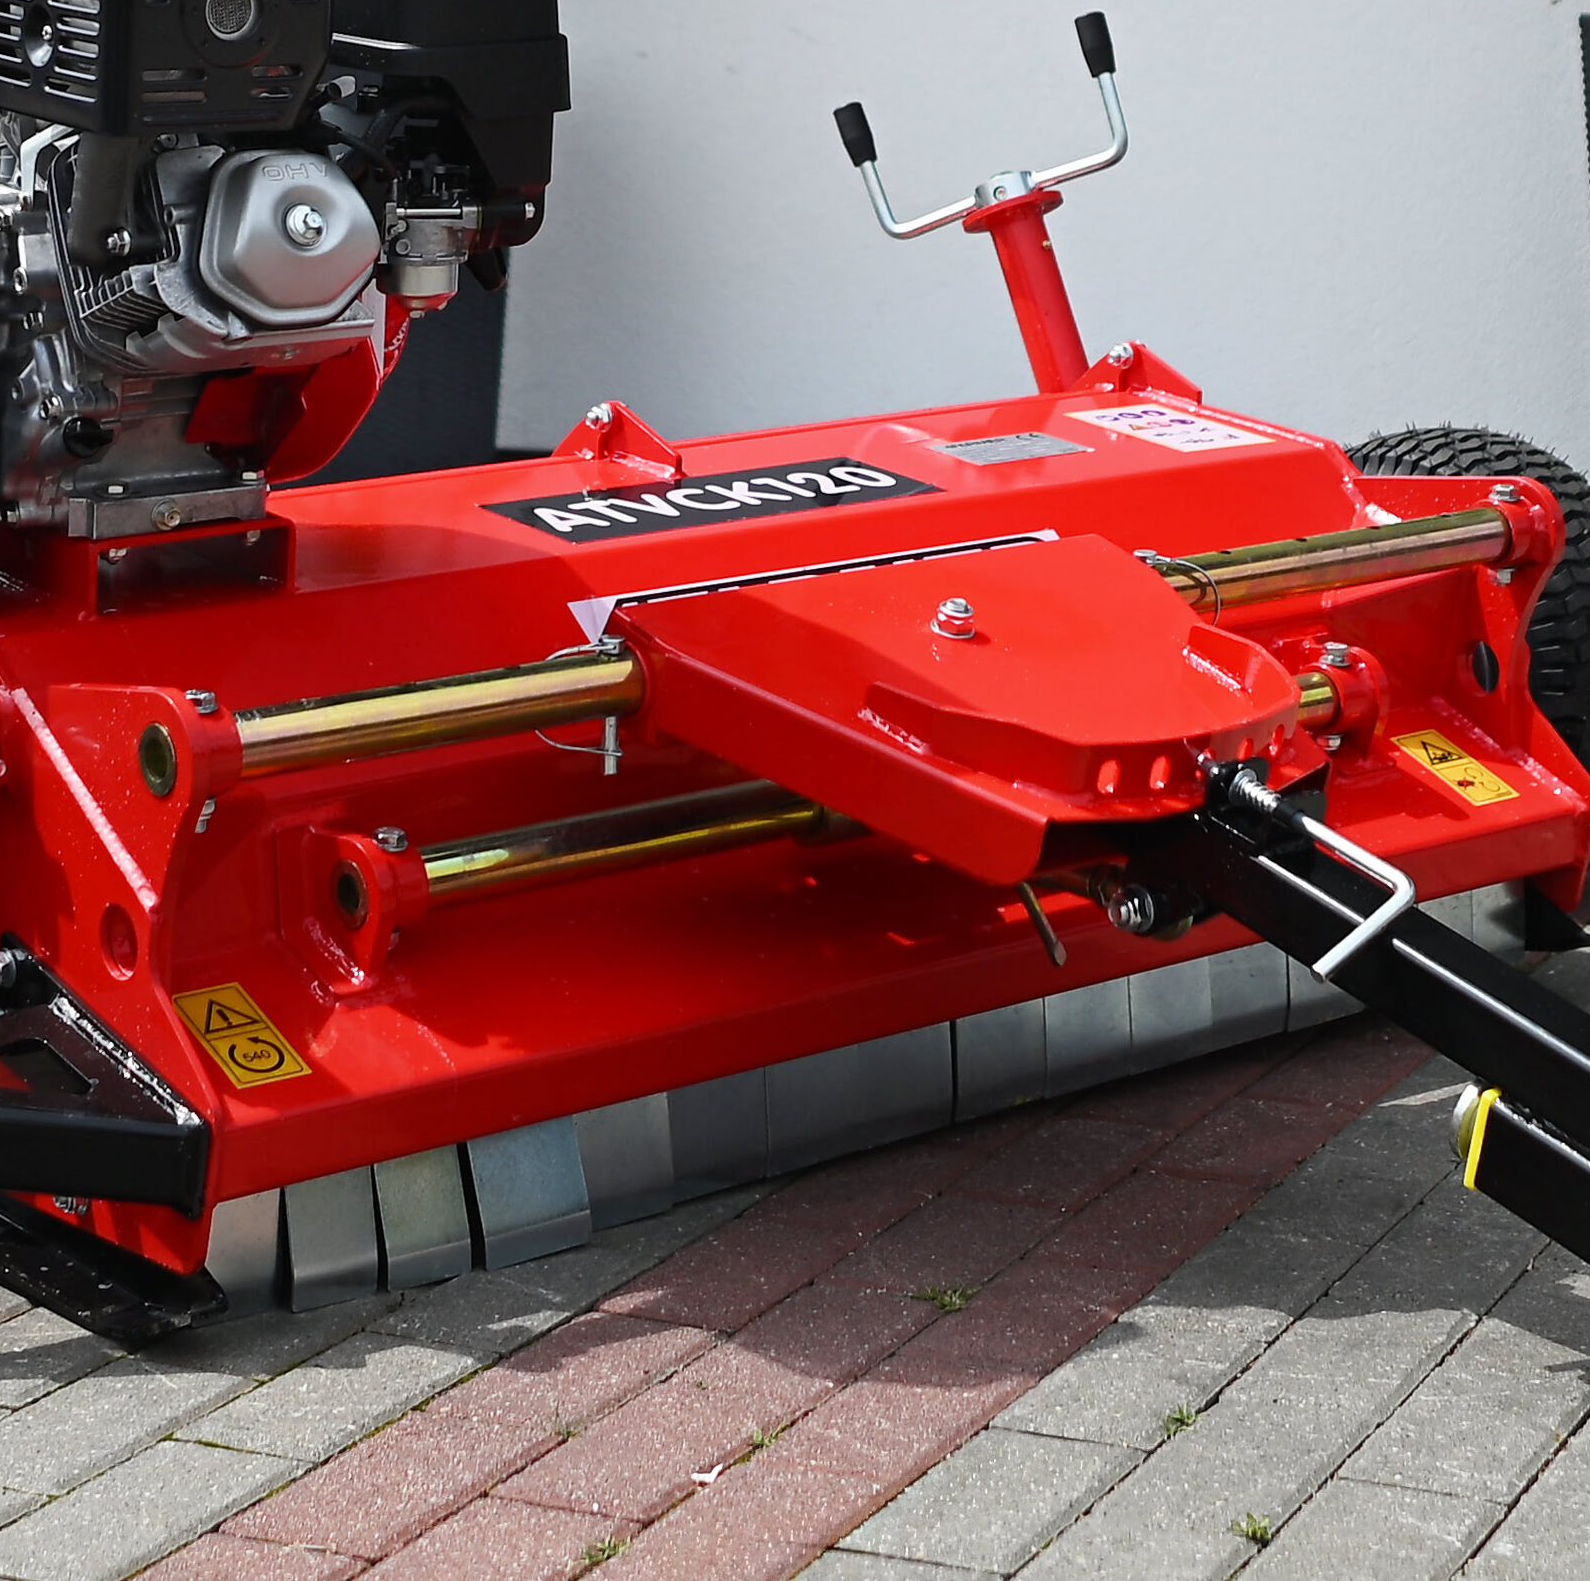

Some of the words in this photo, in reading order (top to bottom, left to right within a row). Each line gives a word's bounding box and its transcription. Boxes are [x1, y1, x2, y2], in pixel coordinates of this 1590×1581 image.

[261, 161, 328, 181] OHV
[533, 465, 897, 533] ATVCK120
[243, 1050, 271, 1062] 540
